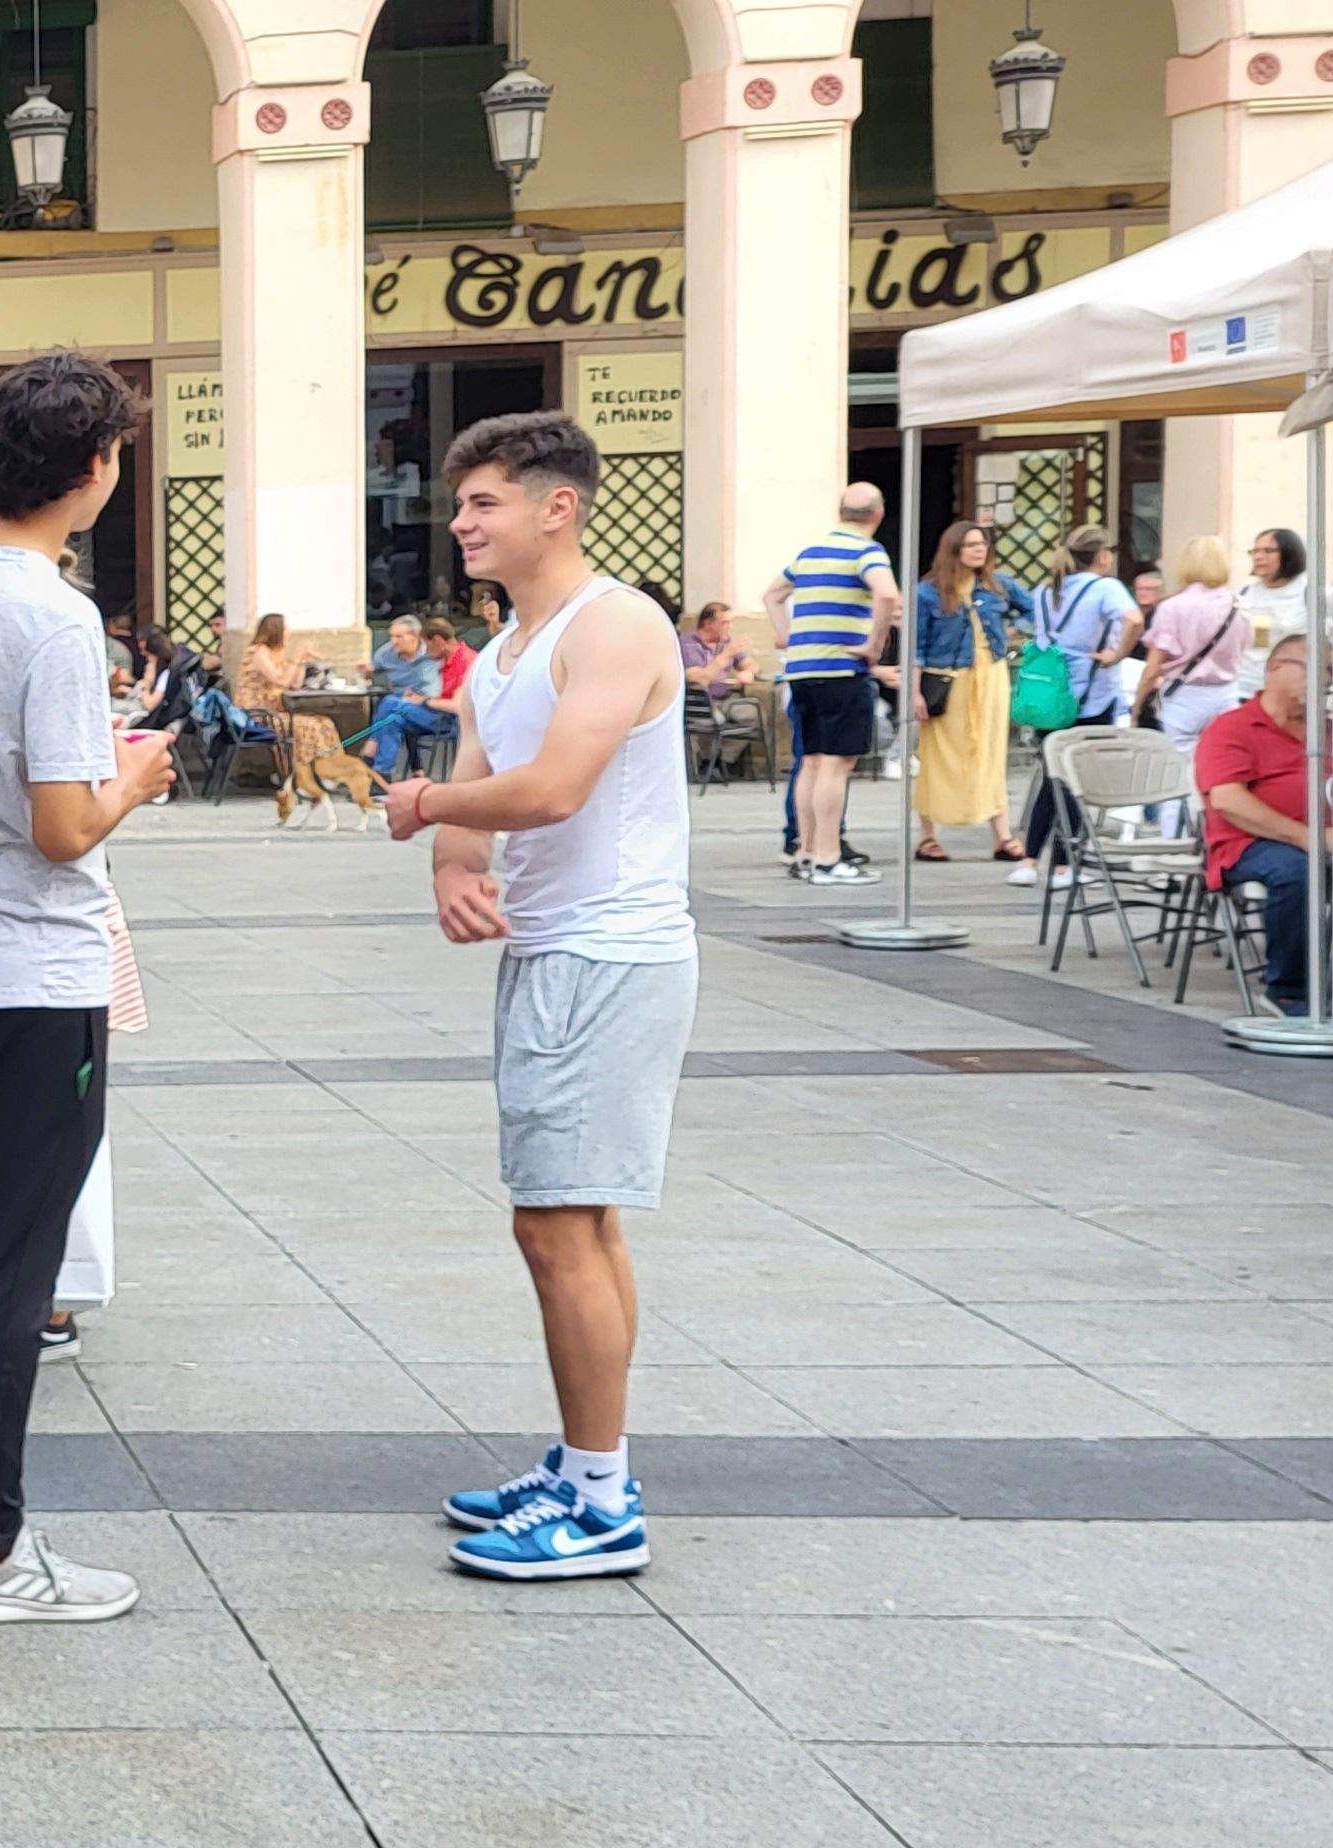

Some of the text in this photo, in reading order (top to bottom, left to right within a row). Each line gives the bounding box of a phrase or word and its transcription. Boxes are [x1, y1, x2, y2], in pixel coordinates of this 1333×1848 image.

[584, 366, 611, 381] TE
[591, 388, 682, 404] RECUERDO
[185, 408, 224, 424] PER
[595, 408, 673, 426] AMANDO
[184, 431, 211, 448] SIN
